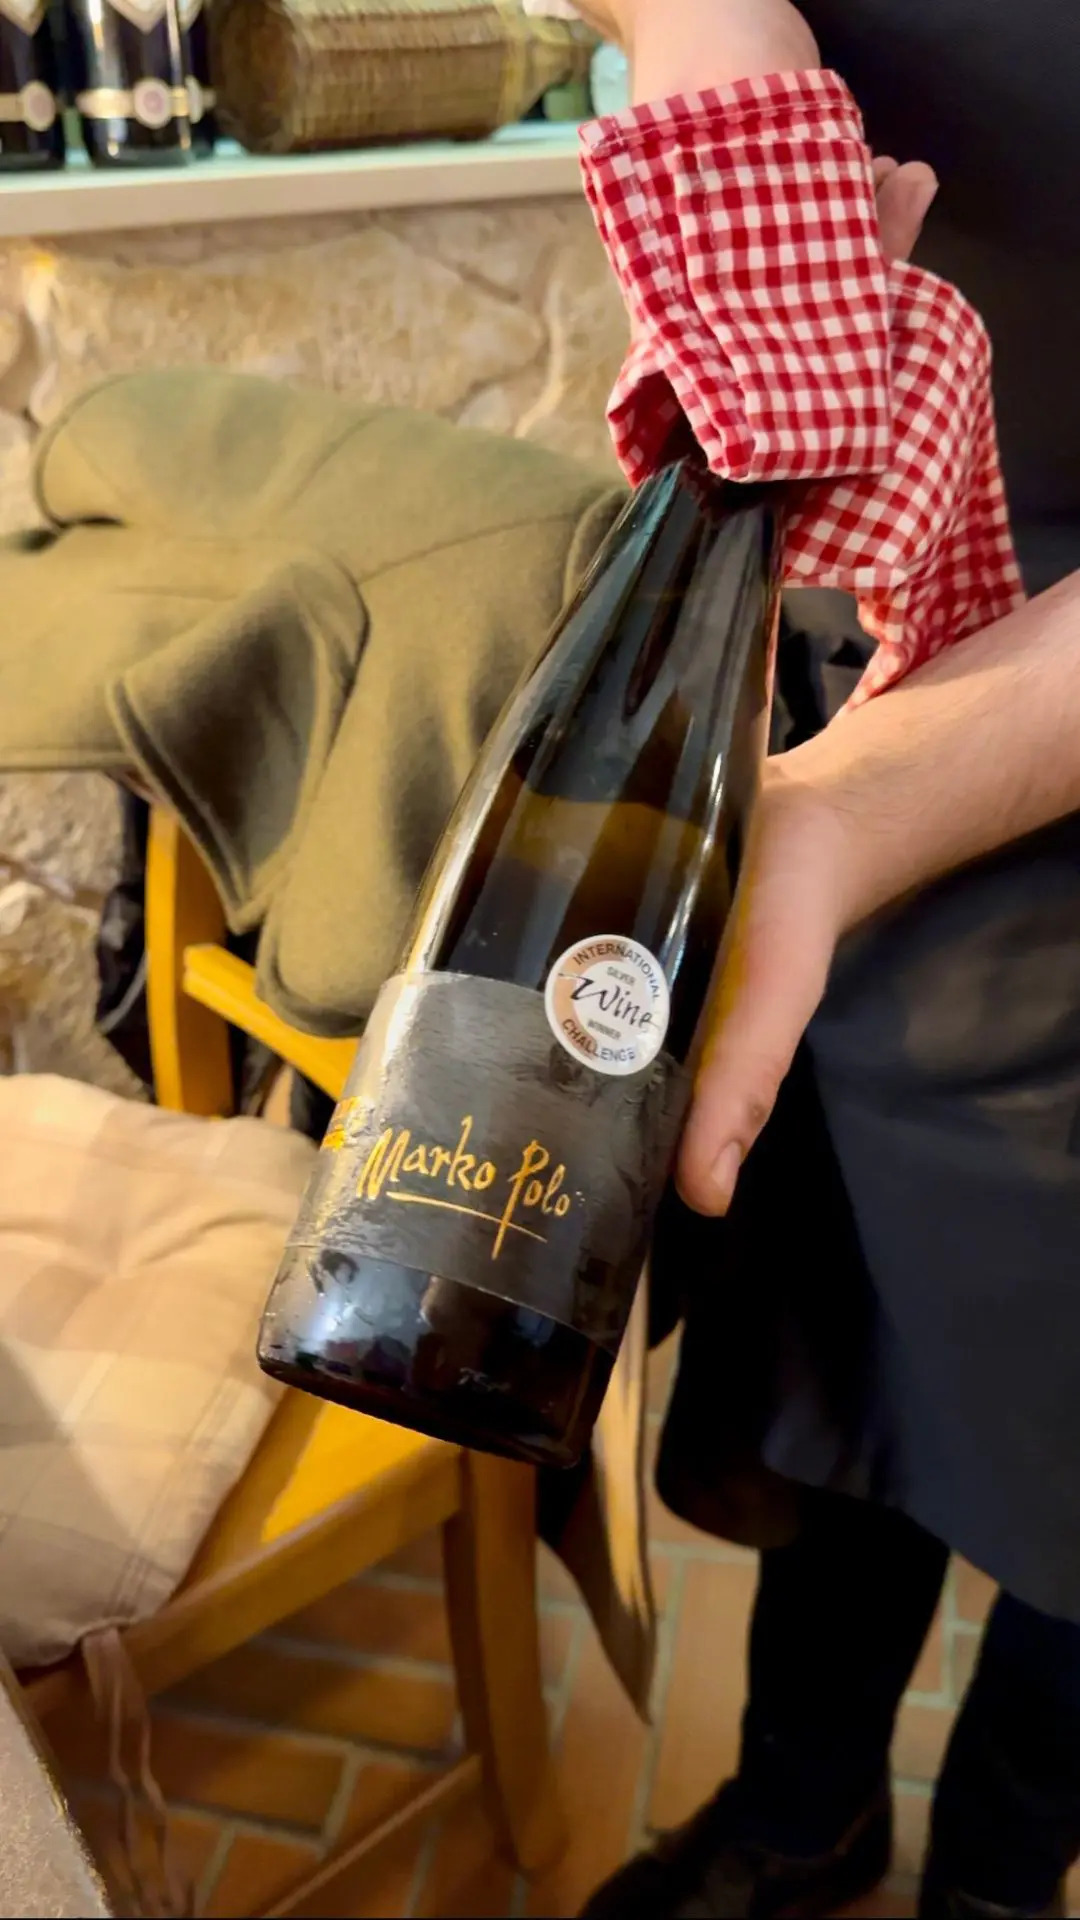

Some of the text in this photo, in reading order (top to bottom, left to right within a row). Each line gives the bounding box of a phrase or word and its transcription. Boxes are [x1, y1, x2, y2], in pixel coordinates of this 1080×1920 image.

[572, 942, 661, 1000] INTERNATIONAL
[557, 972, 660, 1029] Wine
[562, 1018, 637, 1062] CHALLENGE
[354, 1114, 571, 1262] Marko Polo
